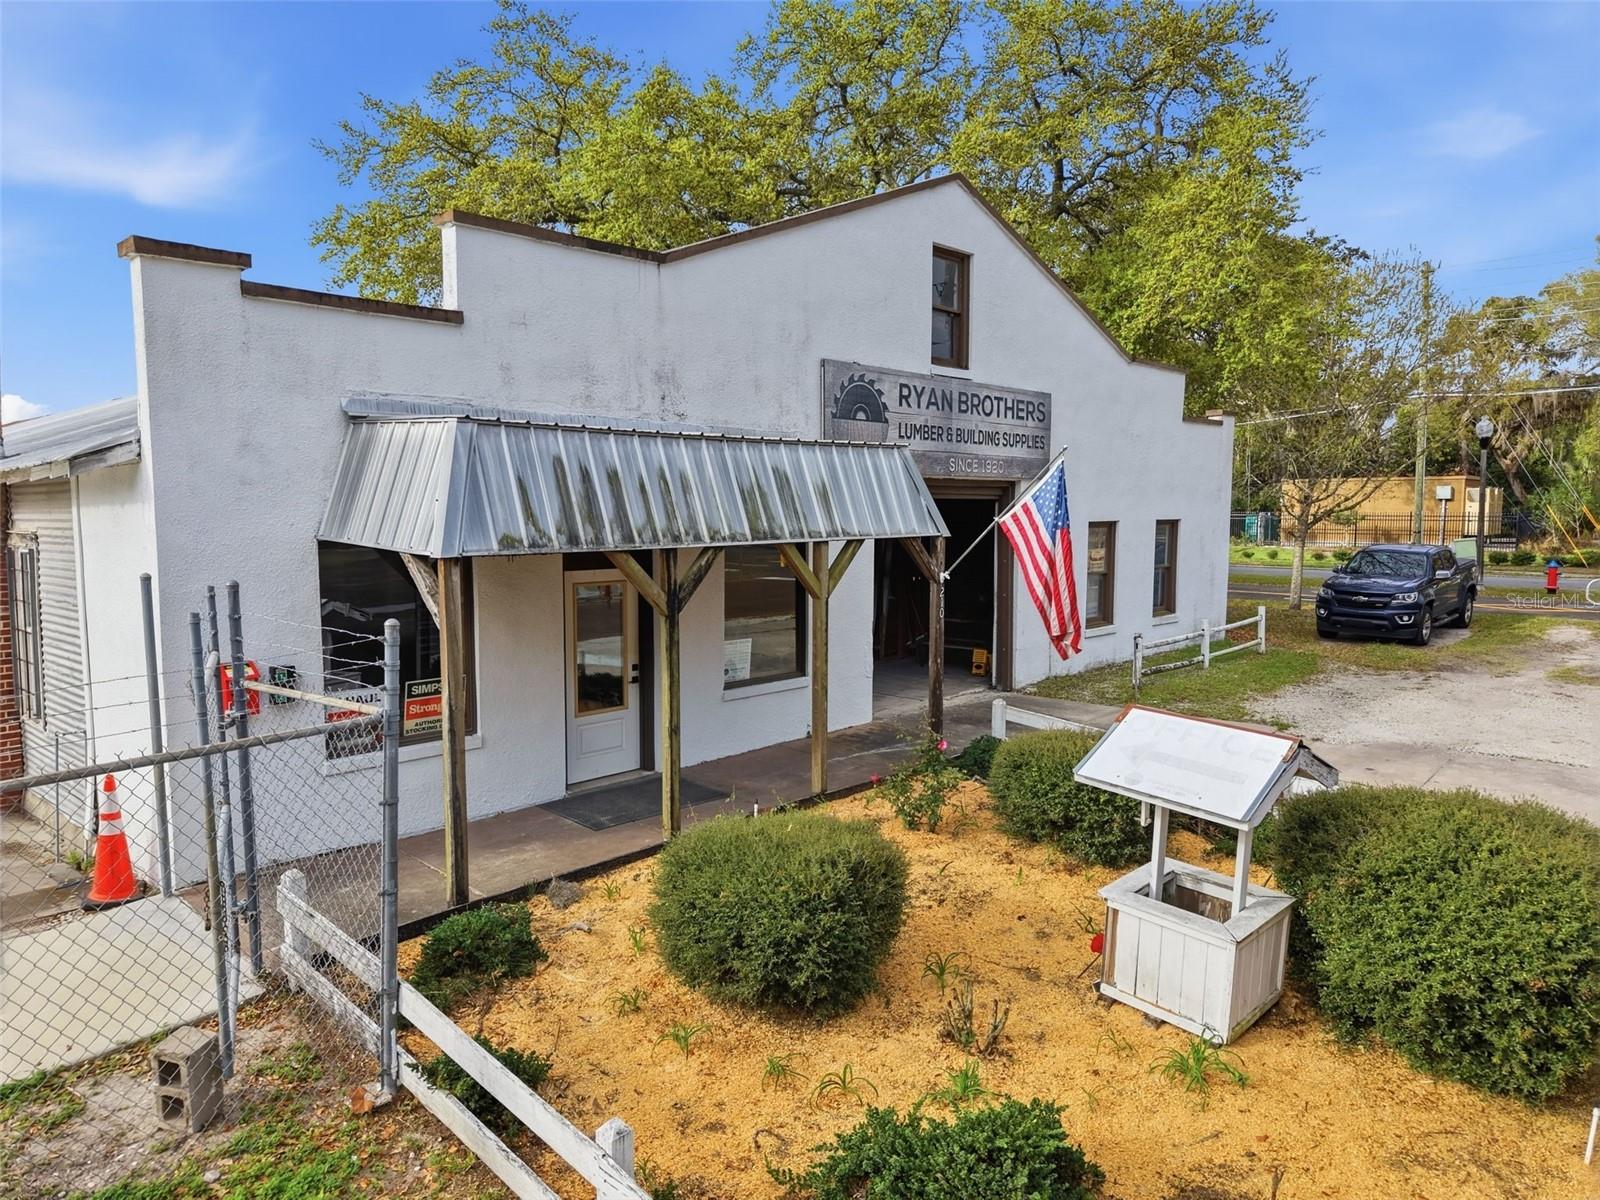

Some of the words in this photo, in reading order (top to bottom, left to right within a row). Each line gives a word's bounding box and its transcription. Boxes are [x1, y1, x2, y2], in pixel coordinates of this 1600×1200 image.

[898, 382, 953, 412] RYAN
[957, 391, 1046, 422] BROTHERS
[898, 422, 944, 442] LUMBER
[946, 426, 953, 443] &
[955, 427, 1000, 447] BUILDING
[1002, 431, 1045, 450] SUPPLIES
[949, 457, 979, 472] SINCE
[982, 459, 1004, 474] 1920
